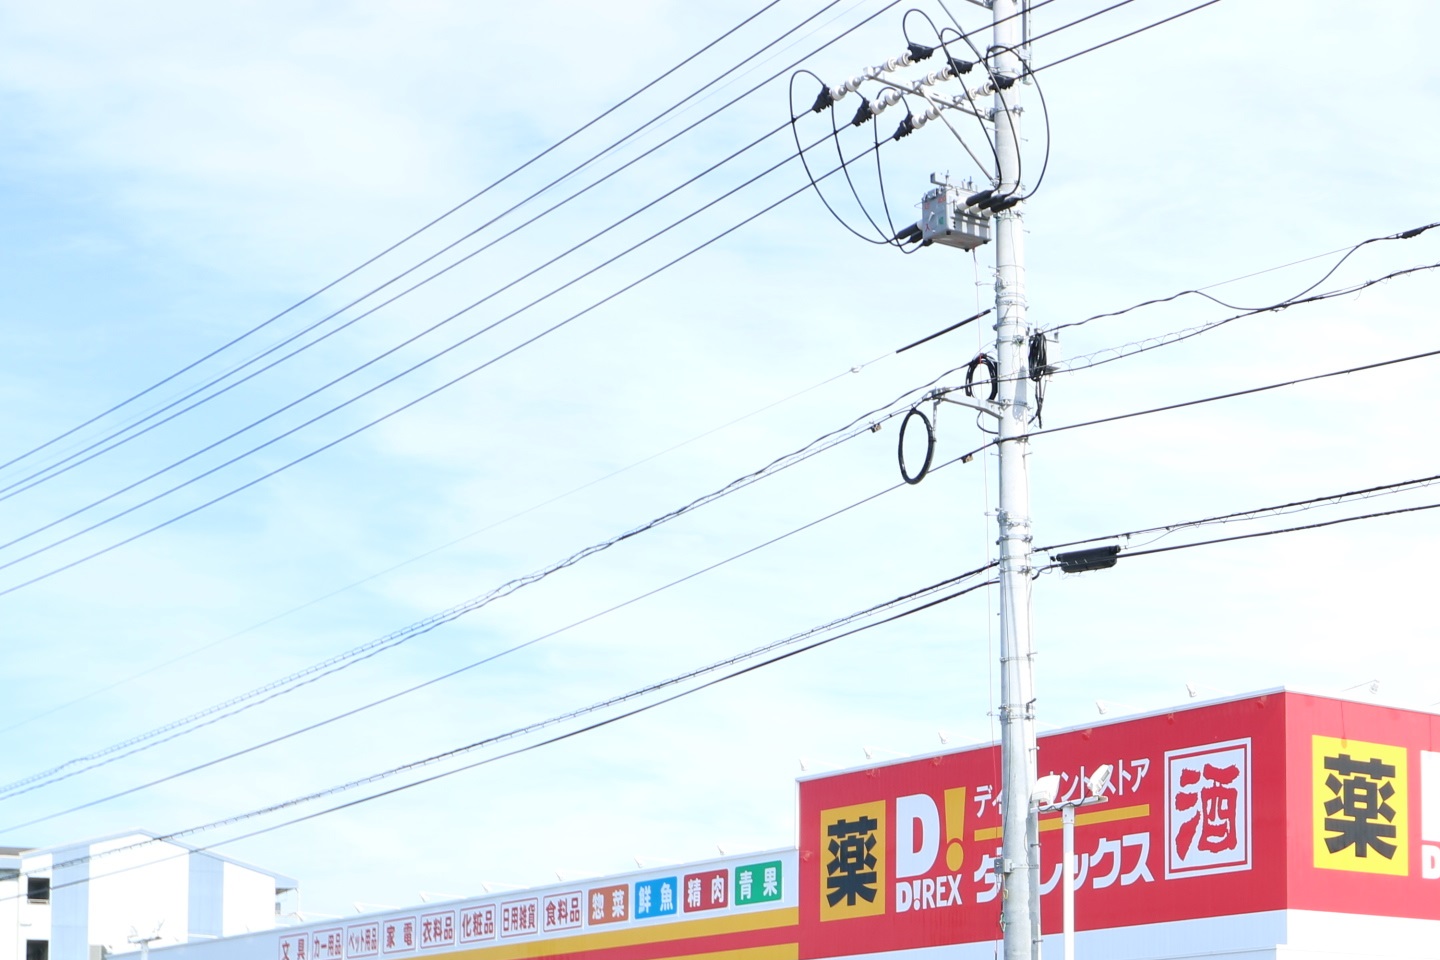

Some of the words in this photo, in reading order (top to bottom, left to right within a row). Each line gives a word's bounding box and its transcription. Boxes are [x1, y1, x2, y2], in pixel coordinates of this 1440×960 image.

[1175, 763, 1240, 861] 酒
[1324, 753, 1398, 860] 薬
[826, 815, 878, 908] 薬
[638, 882, 674, 913] 鮮魚
[687, 875, 724, 908] 精肉
[739, 867, 778, 900] 青果
[503, 903, 536, 931] 日用雑貨
[545, 897, 580, 925] 食料品
[592, 889, 625, 919] 惣菜
[386, 922, 413, 948] 家電
[423, 916, 453, 943] 衣料品
[462, 910, 494, 937] 化粧品
[314, 933, 341, 958] カー用品
[349, 927, 377, 953] ペット用品
